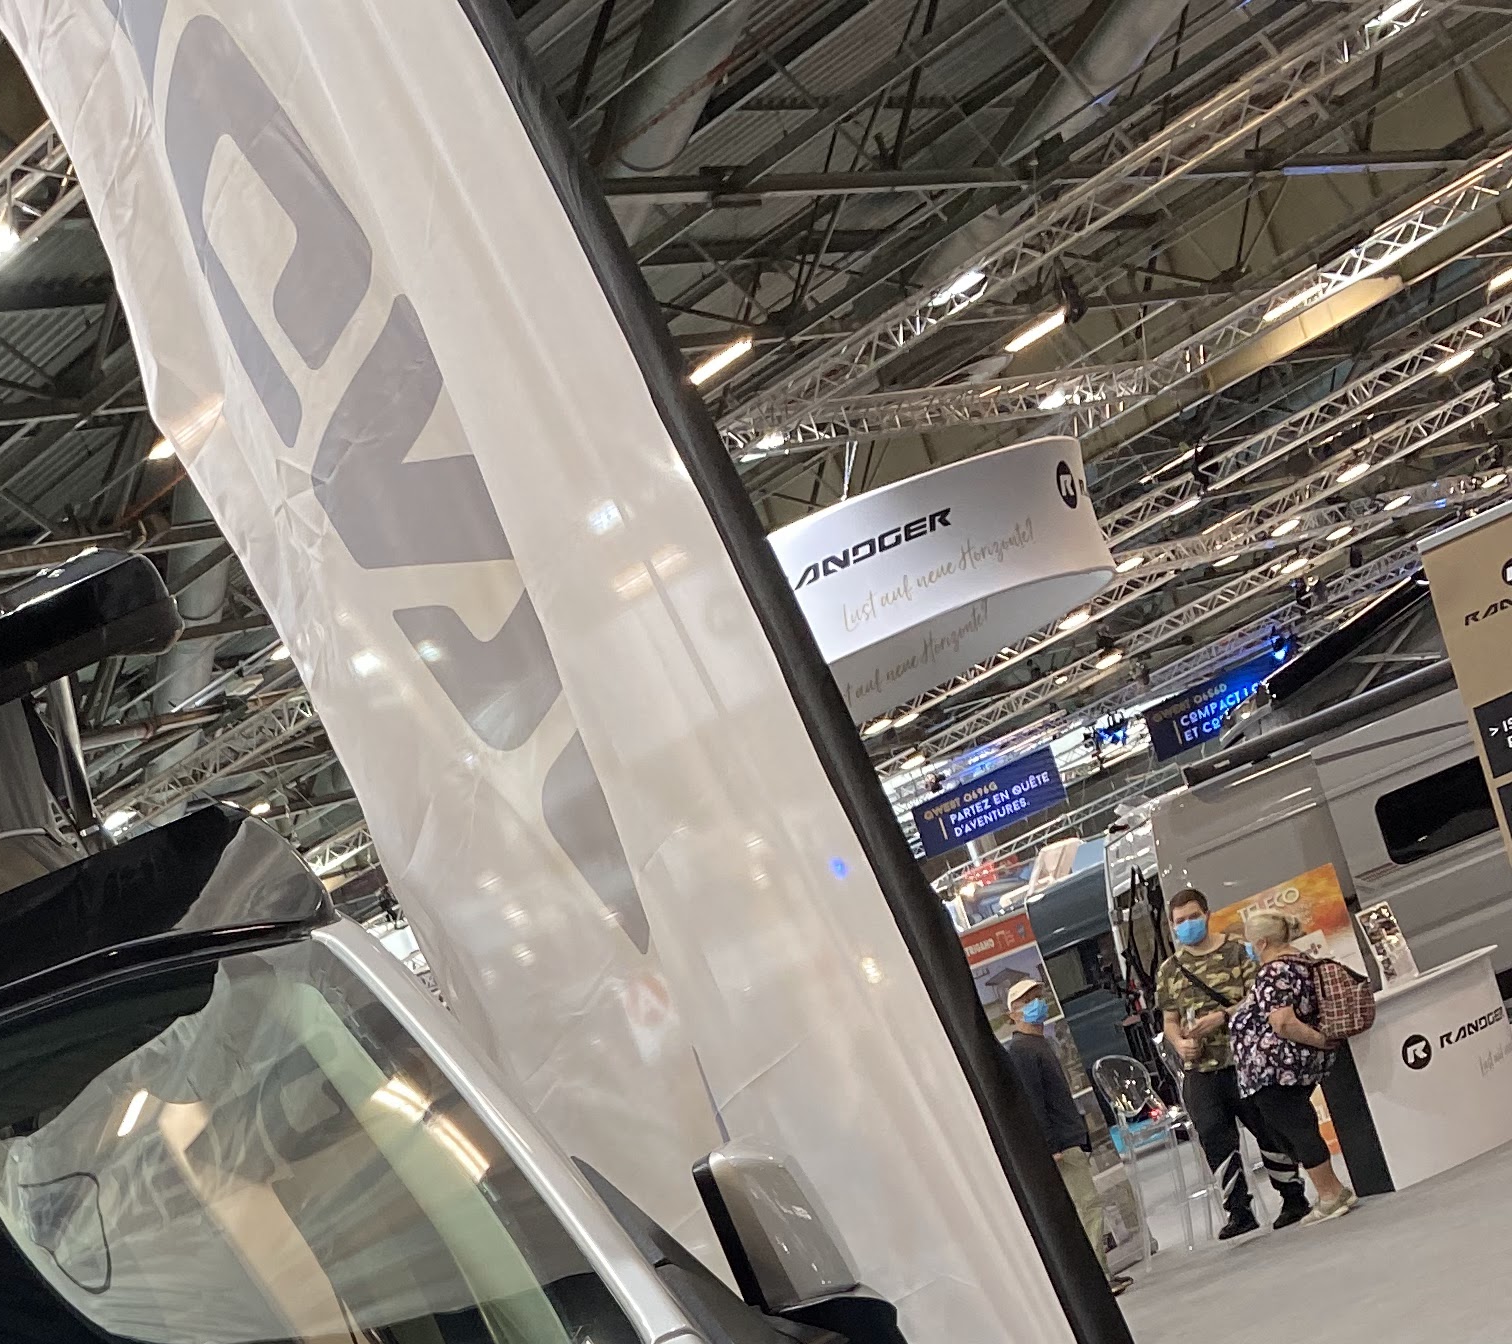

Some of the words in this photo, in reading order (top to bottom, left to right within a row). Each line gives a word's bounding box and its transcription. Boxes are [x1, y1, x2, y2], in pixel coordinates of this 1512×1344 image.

[1180, 692, 1241, 727] COMPACT
[1184, 727, 1200, 742] ET
[949, 798, 992, 825] PARTEZ
[992, 789, 1011, 807] EN
[1011, 771, 1051, 796] QUÊTE
